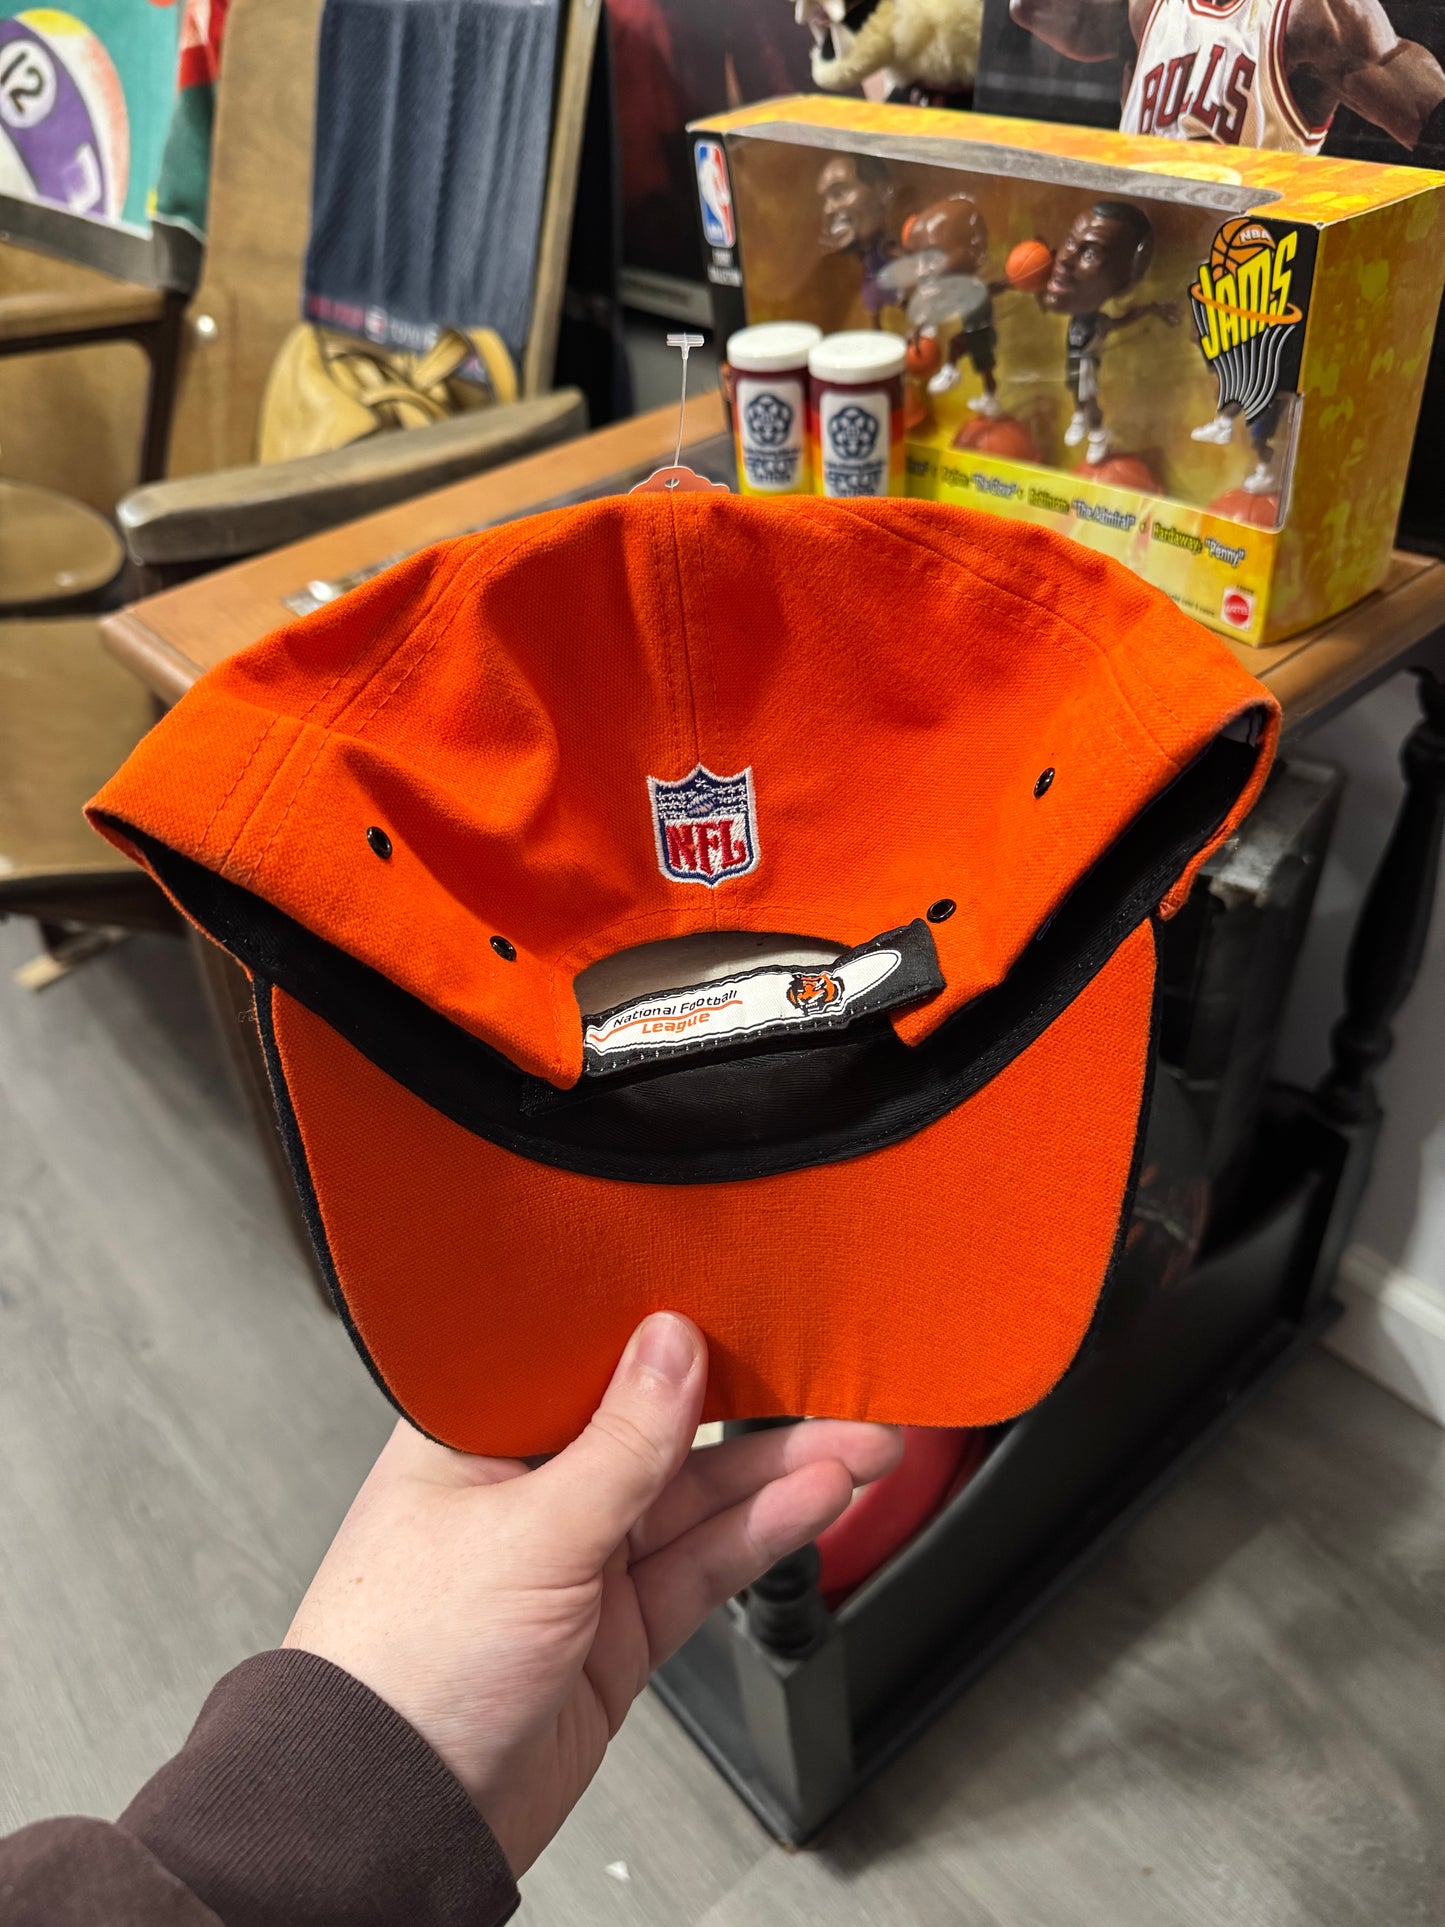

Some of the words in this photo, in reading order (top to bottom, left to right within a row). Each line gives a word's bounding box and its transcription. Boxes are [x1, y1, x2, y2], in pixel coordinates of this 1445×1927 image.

[1139, 44, 1255, 144] BULLS
[1239, 228, 1270, 243] NBA
[1199, 230, 1298, 361] JAMS
[666, 819, 747, 875] NFL
[614, 1005, 677, 1027] National
[682, 990, 738, 1013] Football
[641, 1013, 711, 1034] League
